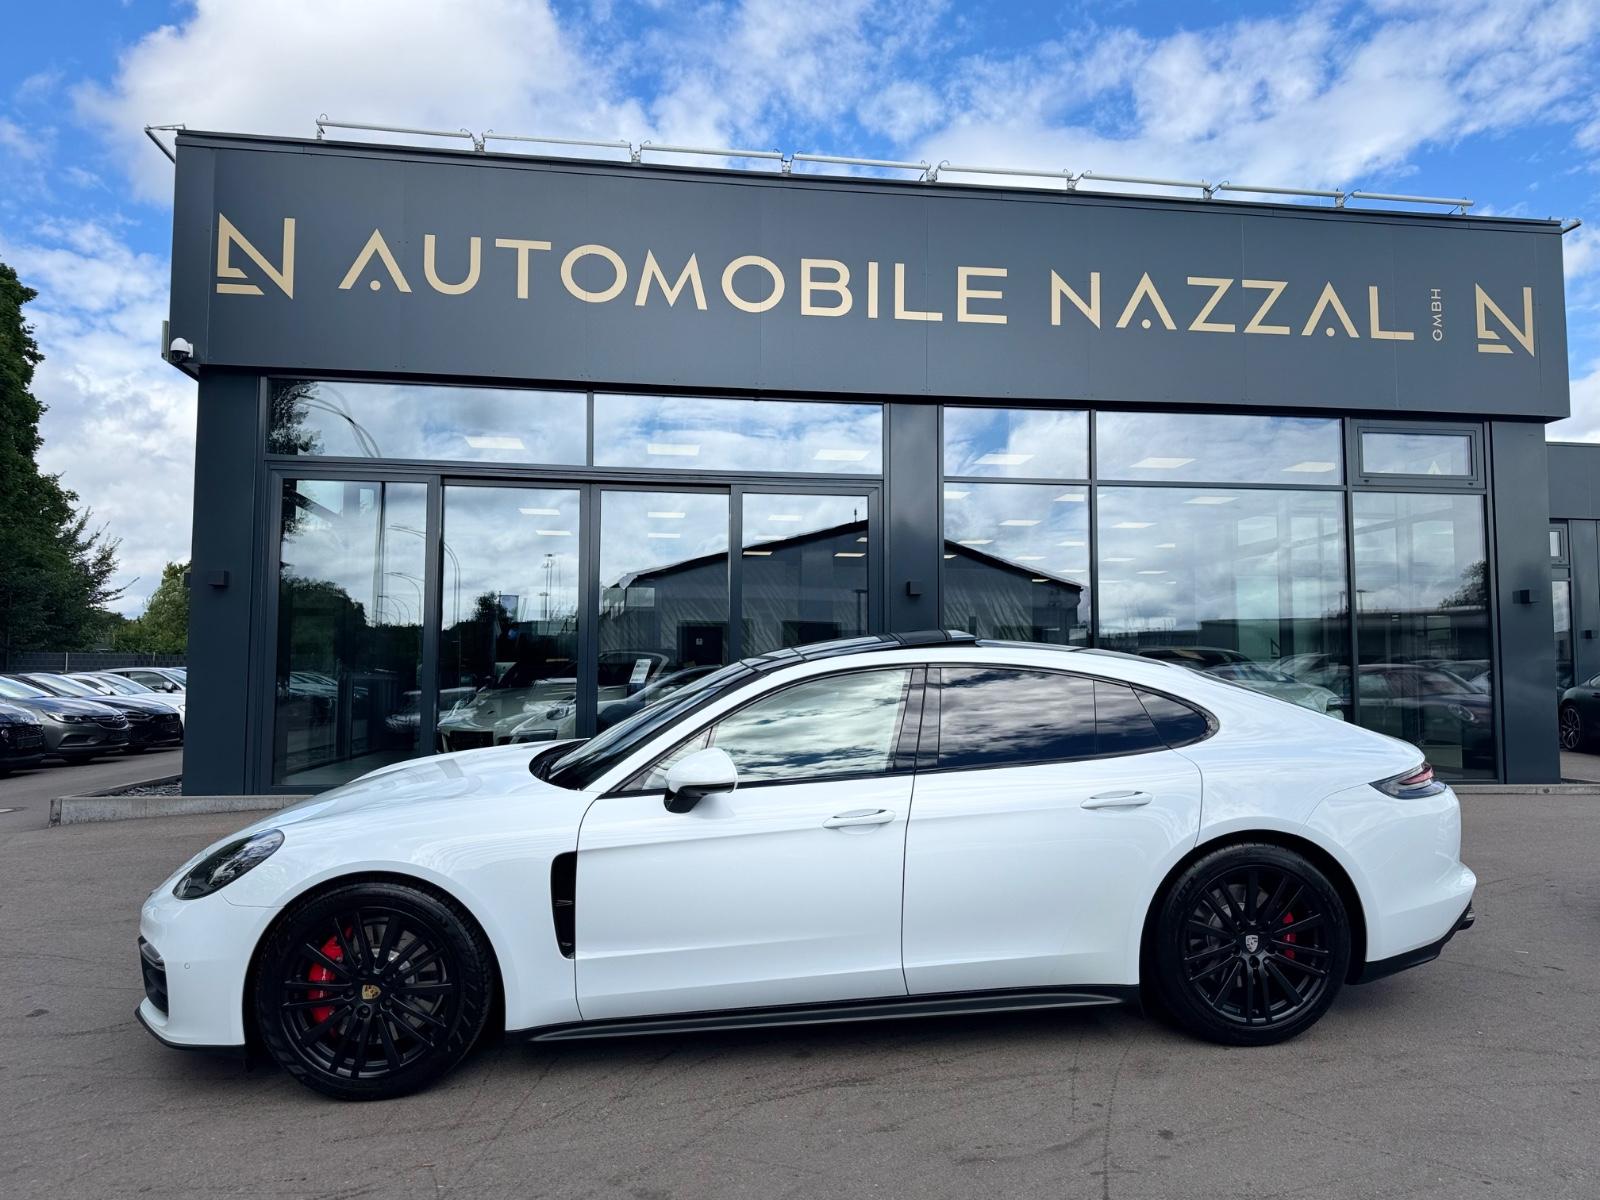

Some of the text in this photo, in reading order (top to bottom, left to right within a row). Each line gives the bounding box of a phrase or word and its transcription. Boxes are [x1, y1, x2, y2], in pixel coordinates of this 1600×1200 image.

[338, 228, 1415, 341] AUTOMOBILE NAZZAL
[1430, 288, 1443, 342] GMBH
